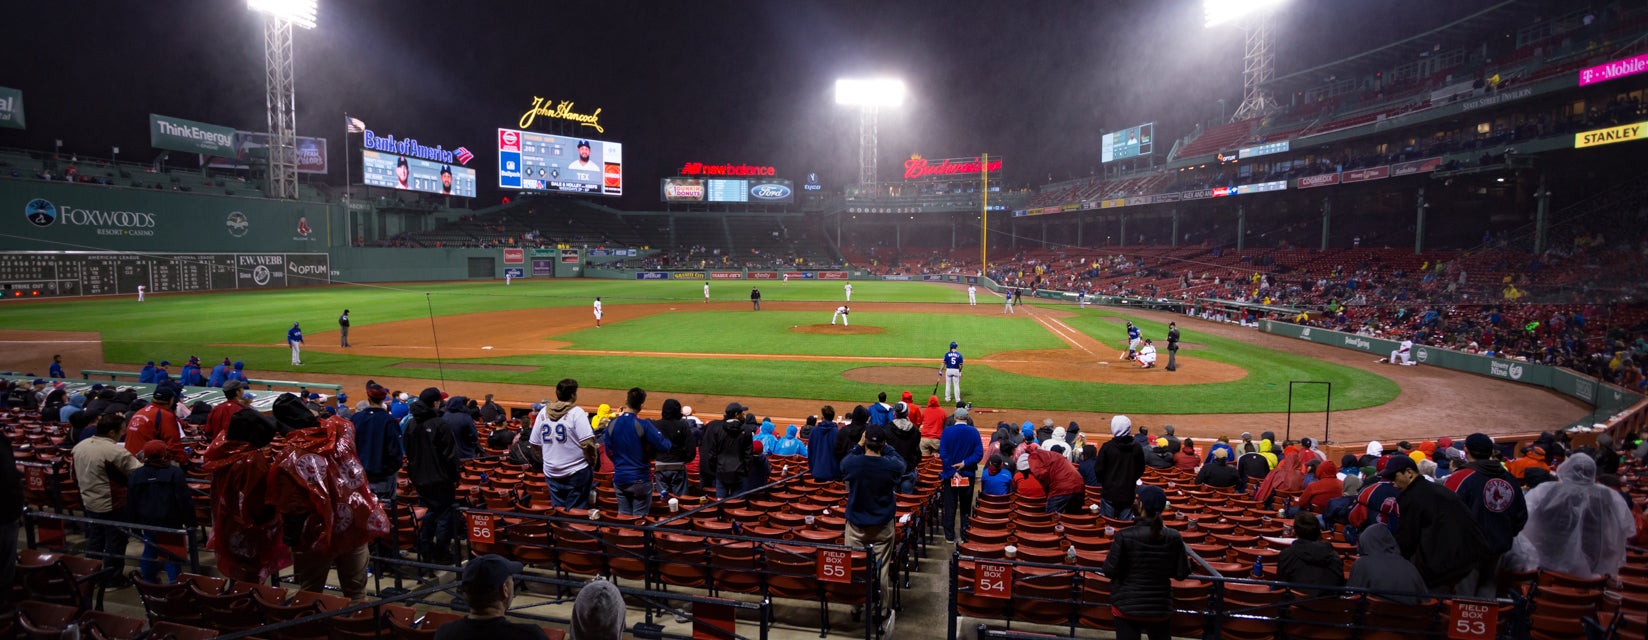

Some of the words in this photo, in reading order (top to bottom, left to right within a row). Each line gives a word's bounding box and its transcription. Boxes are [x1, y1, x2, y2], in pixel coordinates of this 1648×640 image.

[1501, 88, 1532, 102] PAVILION
[519, 96, 557, 128] John
[555, 100, 604, 133] Hancock
[157, 121, 232, 147] ThinkEnergy
[1584, 126, 1640, 144] STANLEY
[364, 129, 397, 153] Bank
[397, 138, 411, 156] of
[410, 139, 454, 163] America
[702, 164, 727, 175] new
[727, 162, 776, 176] balance
[904, 157, 1002, 179] Budweiser
[577, 172, 589, 180] TEX
[415, 179, 421, 189] 2
[758, 186, 783, 197] Ford
[240, 256, 256, 265] F.W.
[256, 255, 283, 265] WEBB
[298, 265, 327, 274] OPTUM
[951, 357, 957, 365] 5
[1491, 360, 1509, 370] Ninety
[1490, 366, 1508, 377] Nine
[540, 423, 567, 444] 29
[30, 476, 43, 486] 59
[473, 526, 491, 538] 56
[823, 550, 846, 558] FIELD
[825, 556, 842, 564] BOX
[823, 564, 845, 577] 55
[981, 564, 1006, 573] FIELD
[980, 578, 1005, 592] 54
[1458, 603, 1489, 613] FIELD
[1461, 610, 1484, 619] BOX
[1455, 619, 1486, 635] 53
